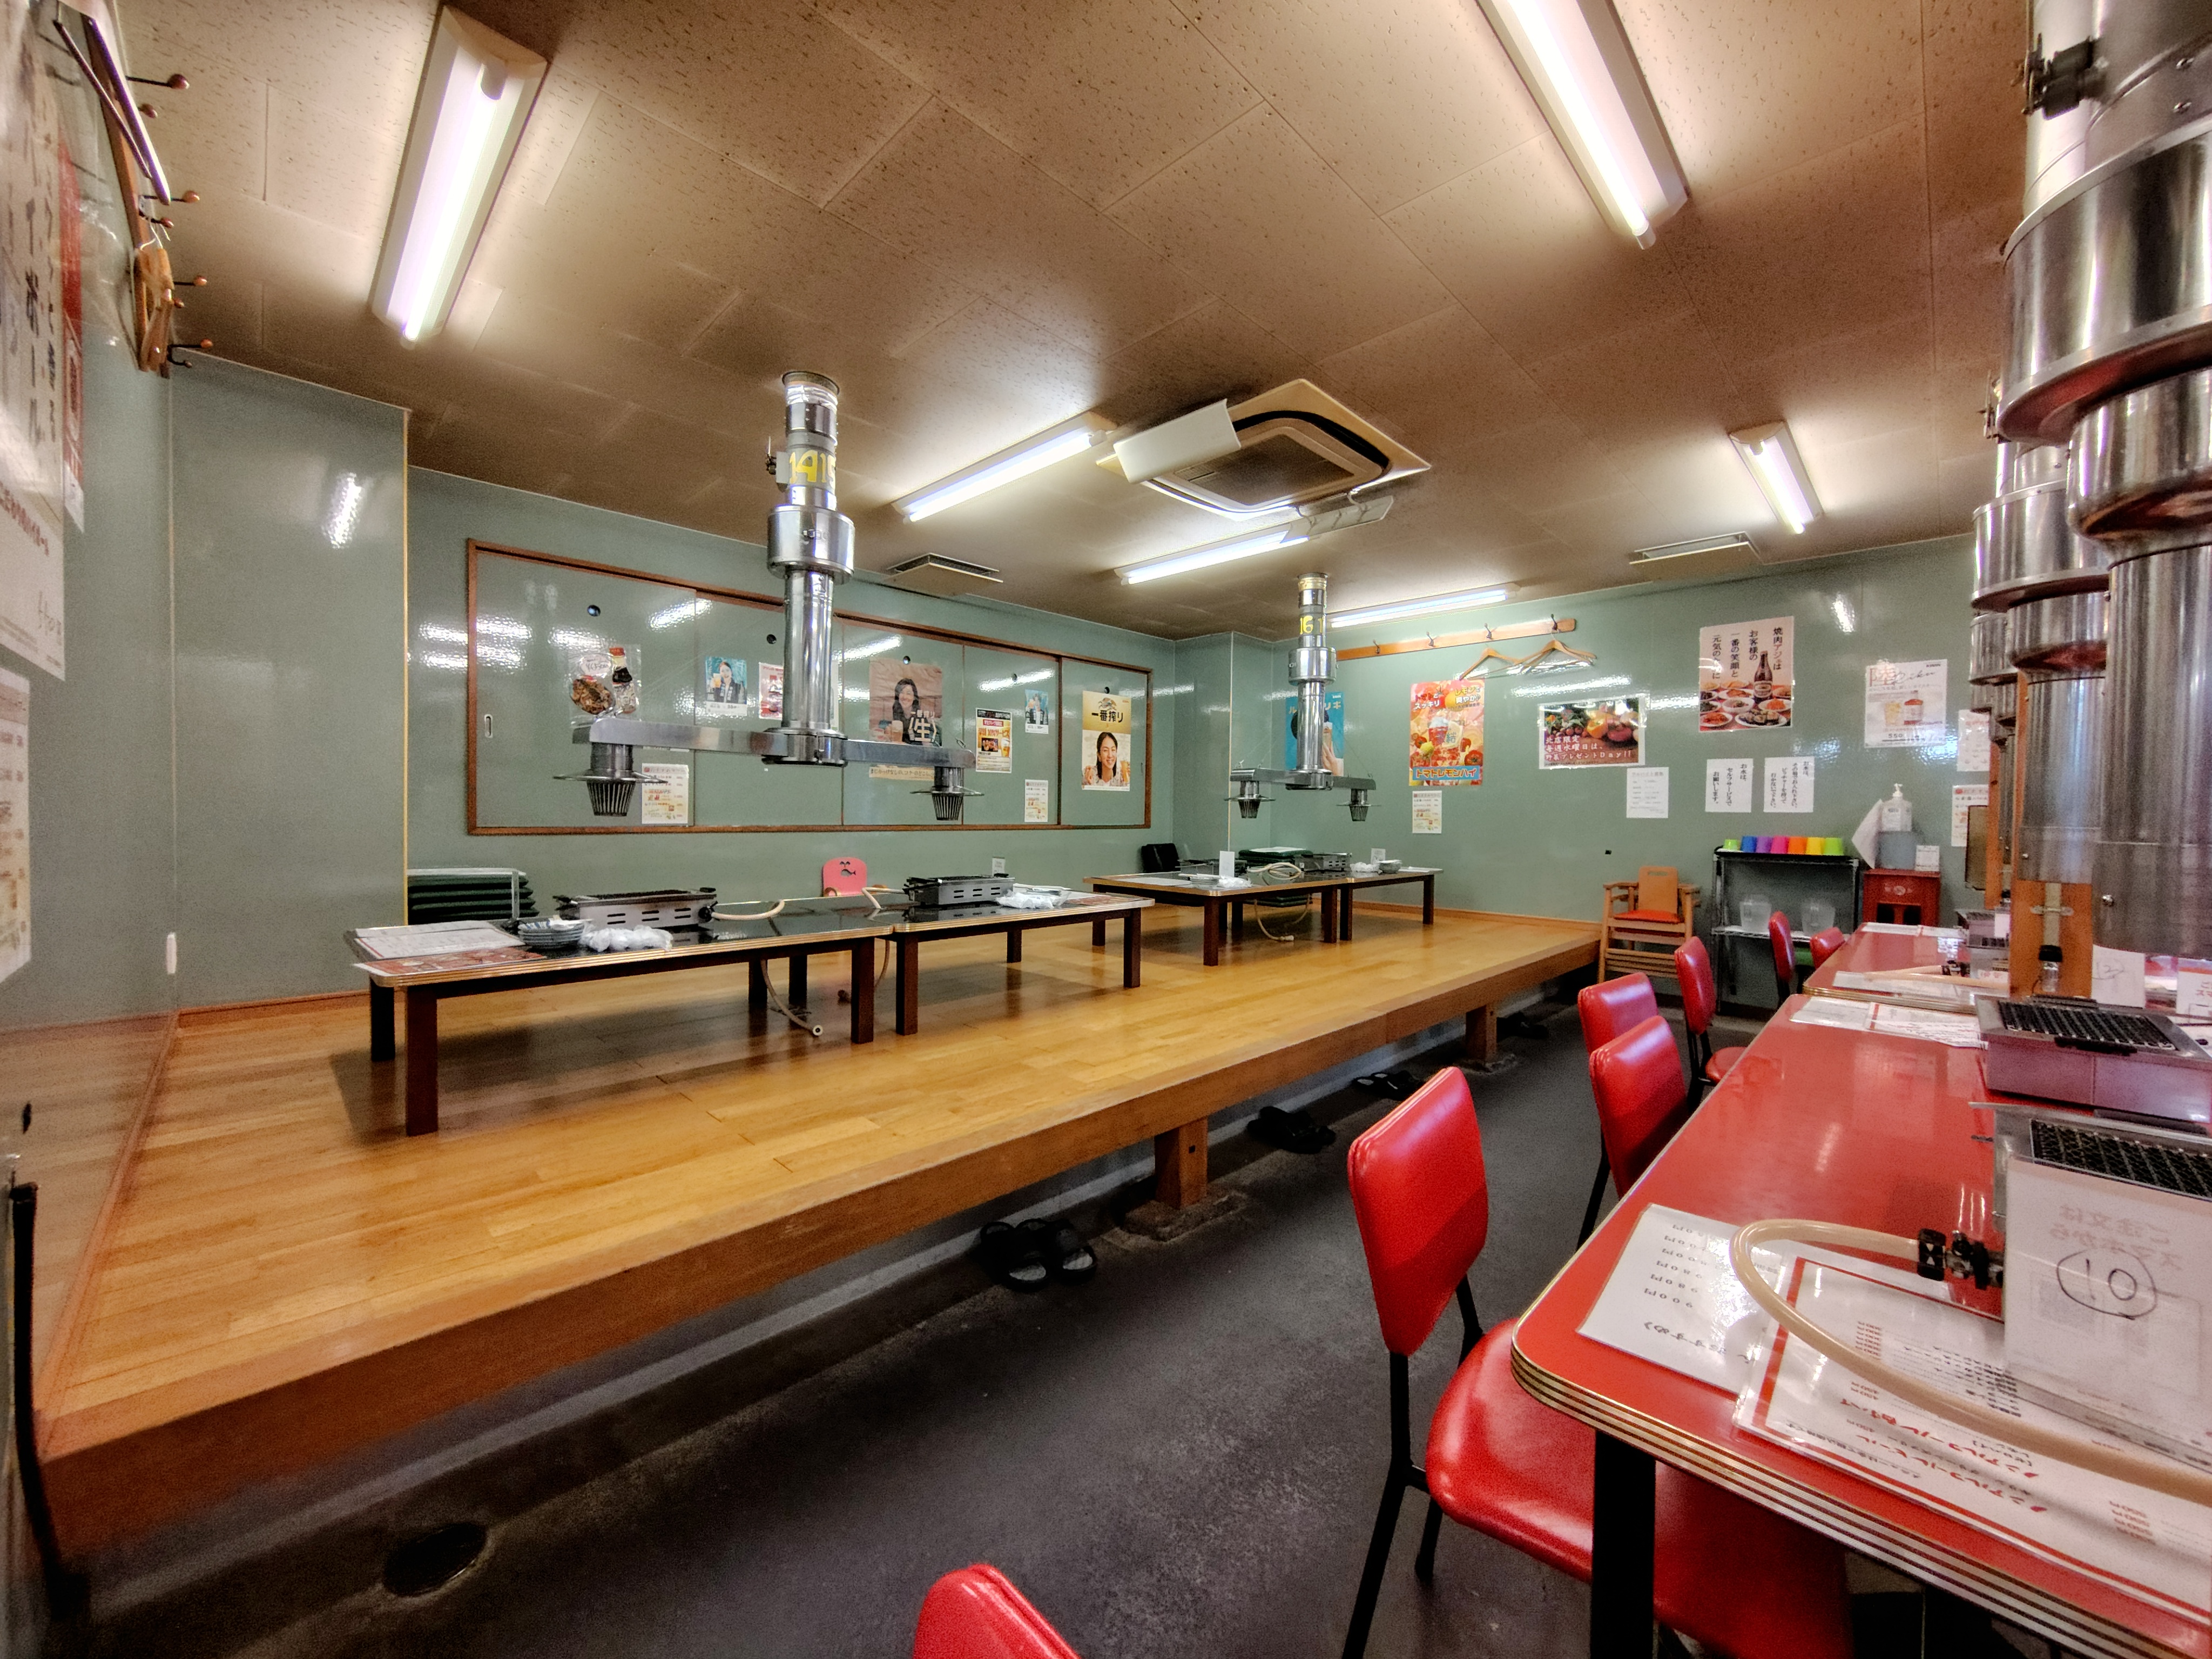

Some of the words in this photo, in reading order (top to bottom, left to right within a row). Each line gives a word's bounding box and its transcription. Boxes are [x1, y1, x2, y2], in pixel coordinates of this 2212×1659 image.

[1730, 632, 1740, 678] 一番の笑顔と
[1749, 630, 1758, 660] お客様の
[1712, 634, 1722, 679] 元気のに
[1414, 700, 1440, 710] スッキリ
[1091, 710, 1124, 723] 一番搾り
[1417, 768, 1477, 778] トマトレモンハイ
